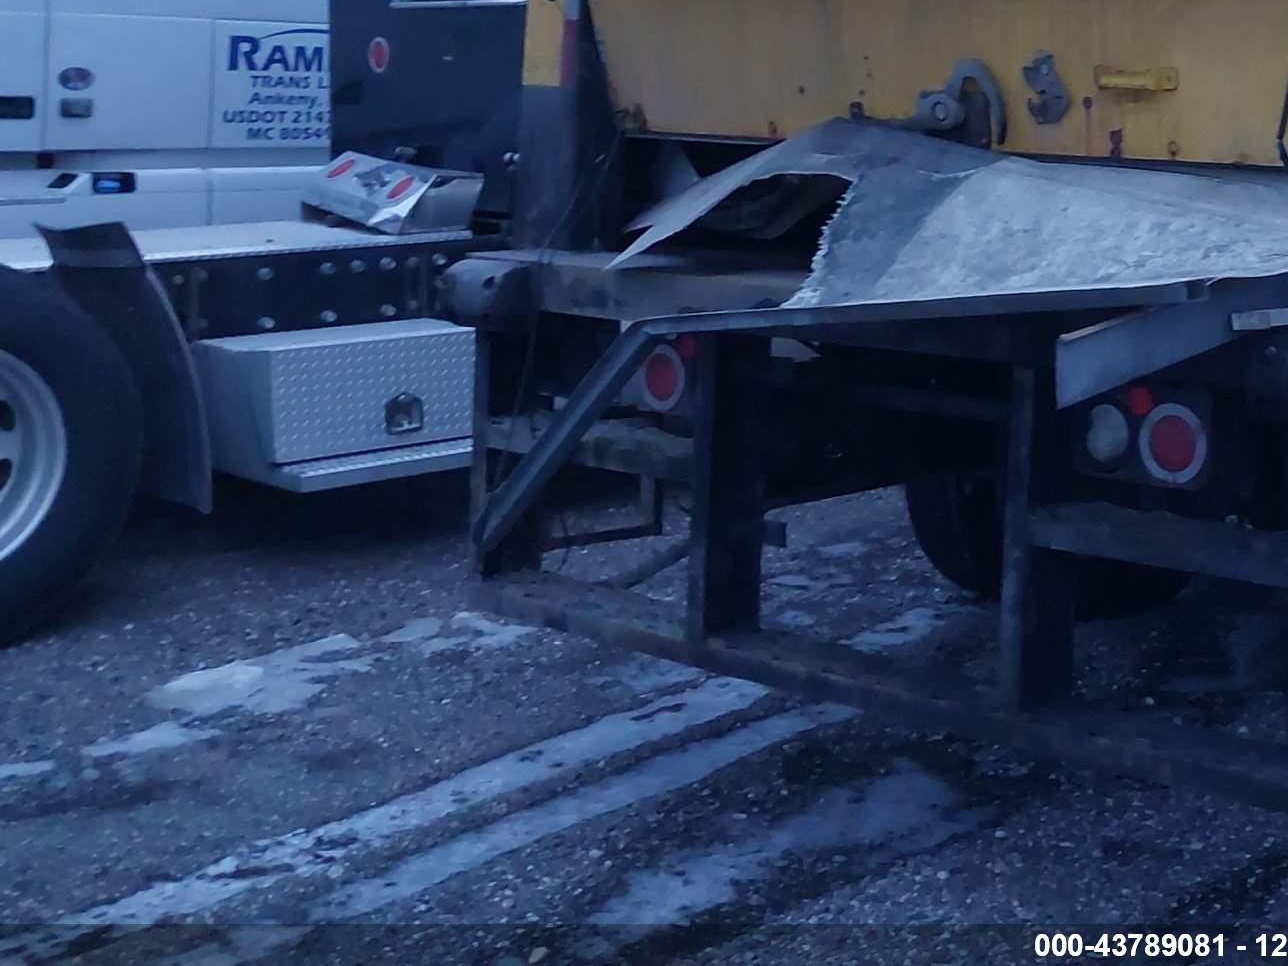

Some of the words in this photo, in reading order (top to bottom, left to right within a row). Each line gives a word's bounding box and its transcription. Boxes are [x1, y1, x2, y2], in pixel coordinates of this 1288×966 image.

[227, 35, 325, 72] RAM
[250, 75, 311, 89] TRANS
[222, 110, 288, 124] USDOT
[246, 127, 274, 140] MC
